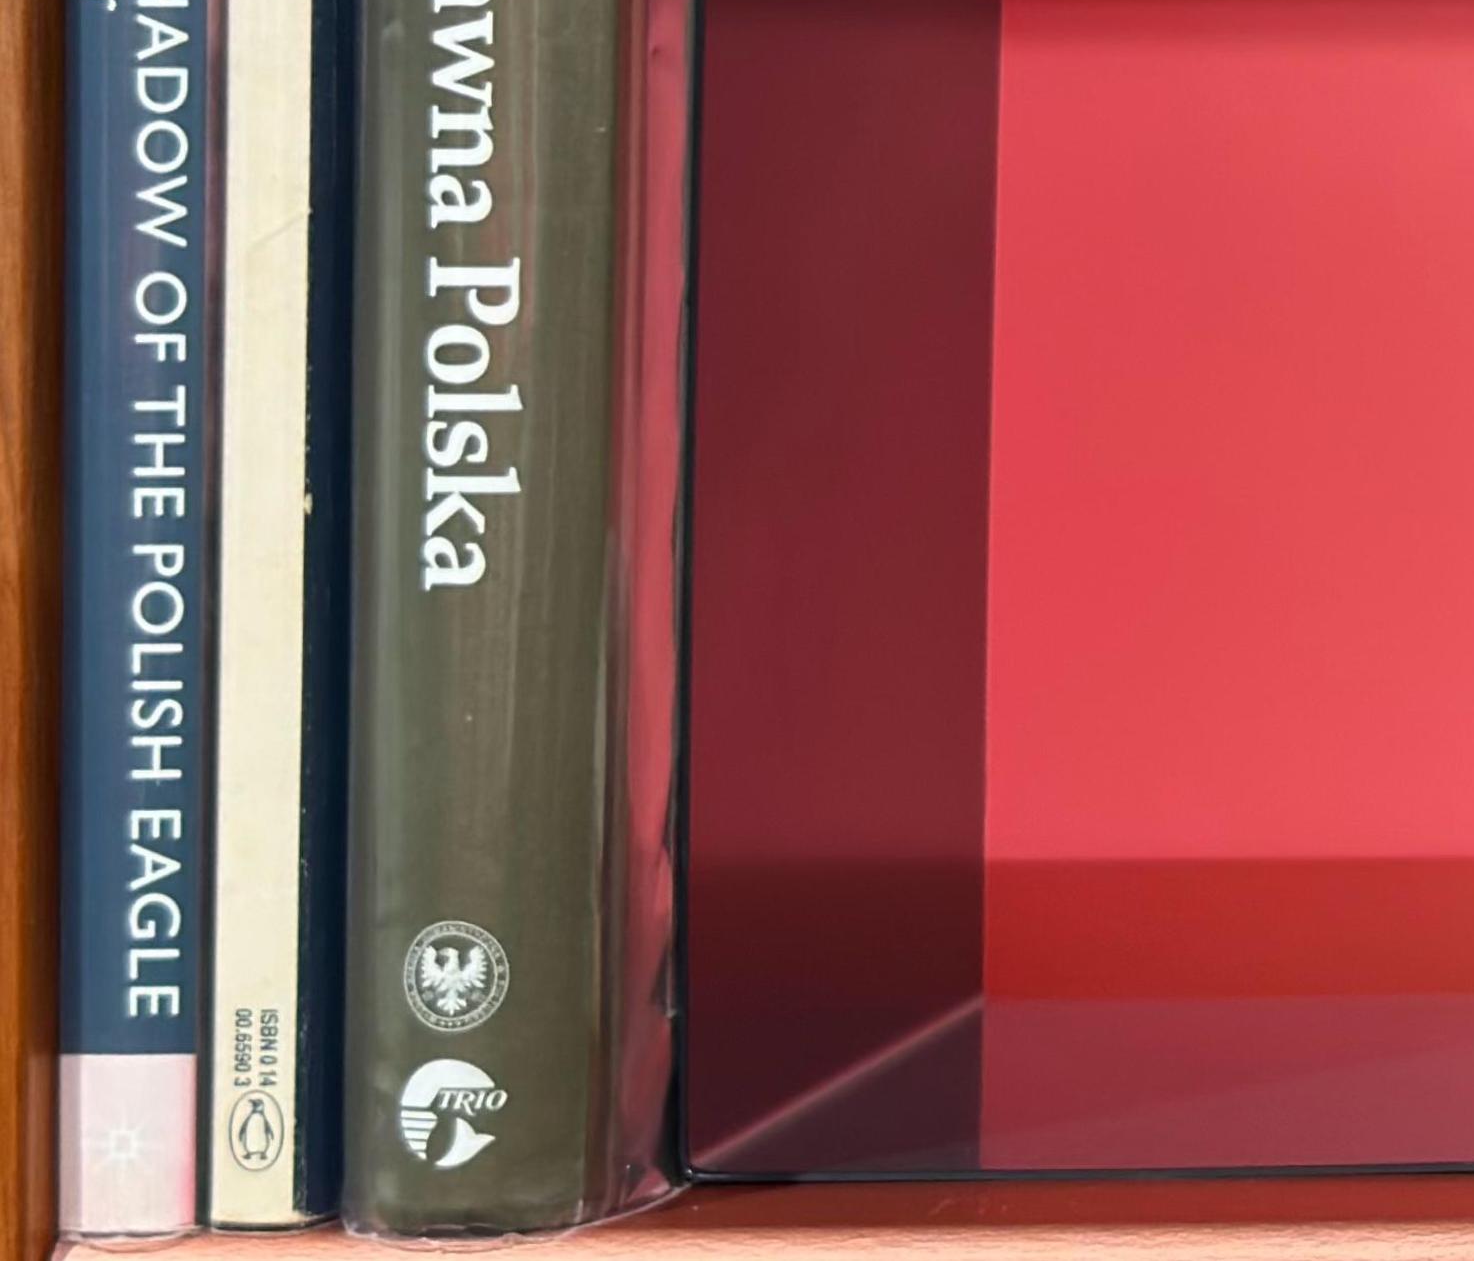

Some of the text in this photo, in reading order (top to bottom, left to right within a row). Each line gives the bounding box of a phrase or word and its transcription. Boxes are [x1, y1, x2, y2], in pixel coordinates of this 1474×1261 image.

[133, 270, 188, 363] OF
[131, 384, 187, 519] THE
[421, 255, 524, 592] Polska
[129, 543, 185, 781] POLISH
[127, 808, 183, 1018] EAGLE
[258, 1071, 277, 1087] 14
[260, 1008, 279, 1051] ISBN
[438, 1088, 509, 1117] TRIO
